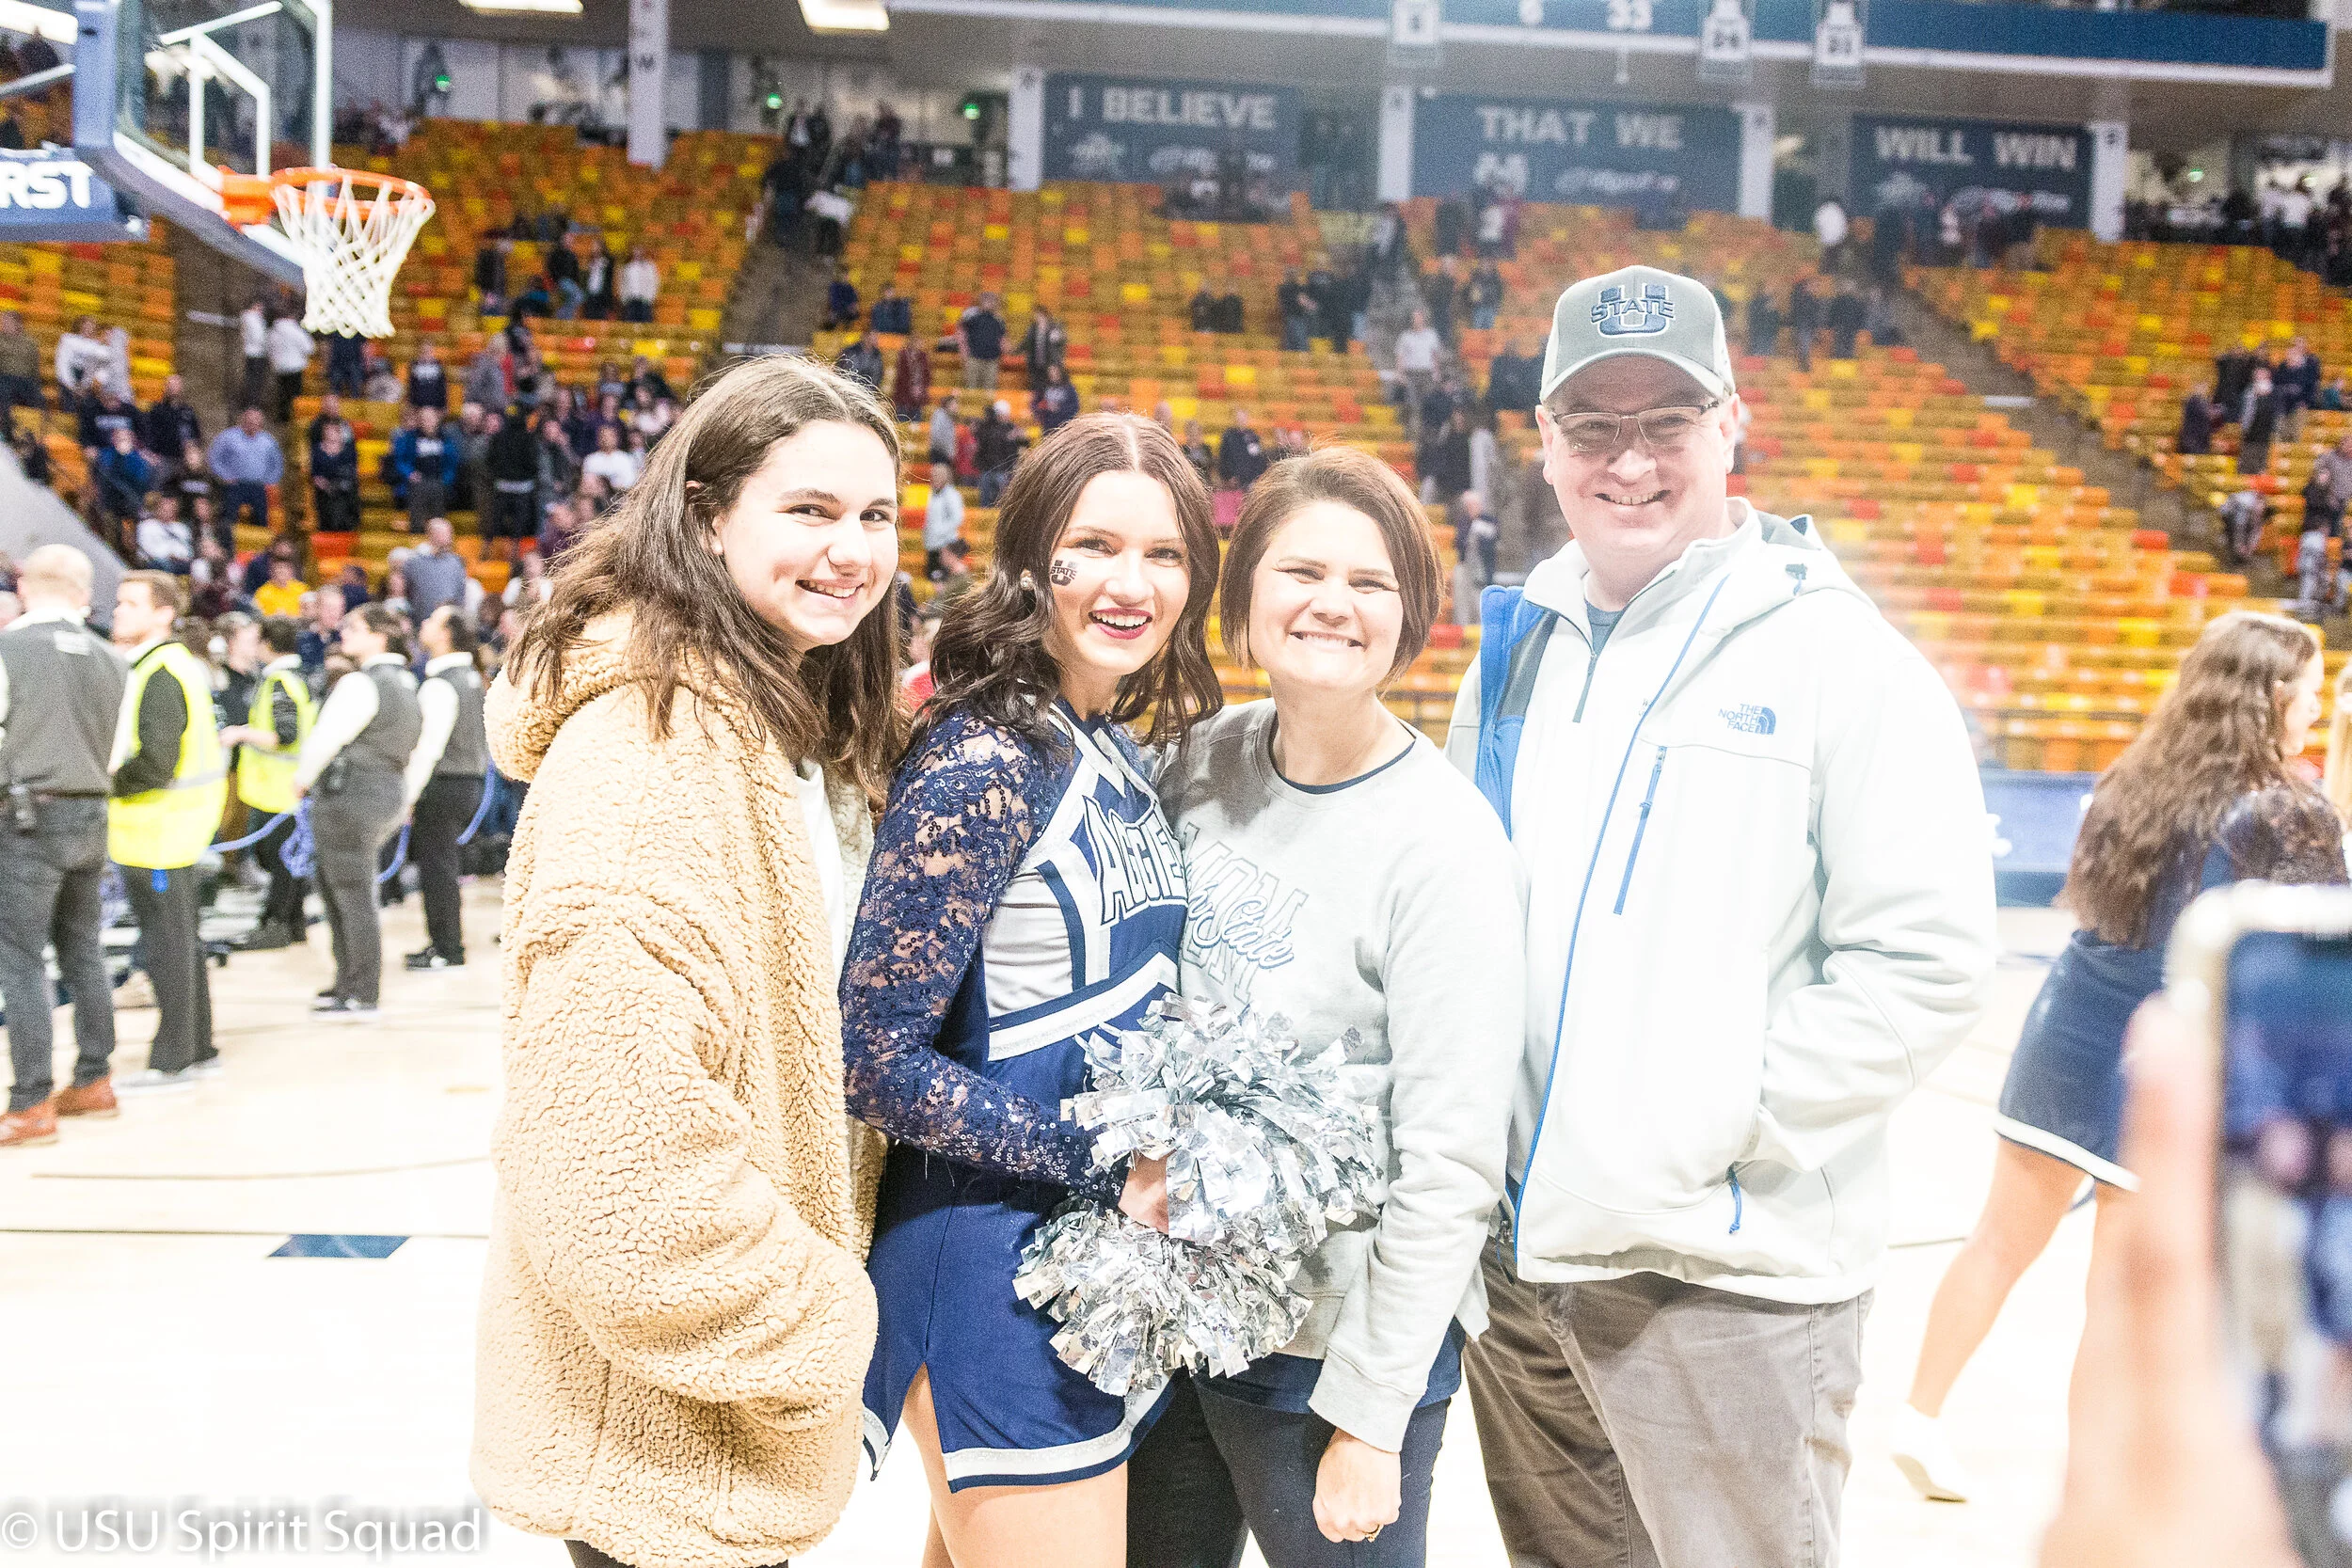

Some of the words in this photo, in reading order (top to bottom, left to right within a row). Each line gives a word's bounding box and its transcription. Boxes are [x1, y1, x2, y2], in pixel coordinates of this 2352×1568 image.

[1068, 86, 1082, 119] I
[1102, 86, 1275, 130] BELIEVE
[1479, 106, 1597, 146] THAT
[1614, 112, 1683, 151] WE
[1875, 125, 1974, 166] WILL
[1993, 131, 2077, 170] WIN
[1590, 297, 1675, 324] STATE
[1050, 565, 1077, 580] STATE
[1718, 708, 1759, 724] NORTH
[1740, 703, 1762, 715] THE
[1727, 721, 1756, 733] FACE
[1082, 795, 1187, 927] AGGIE
